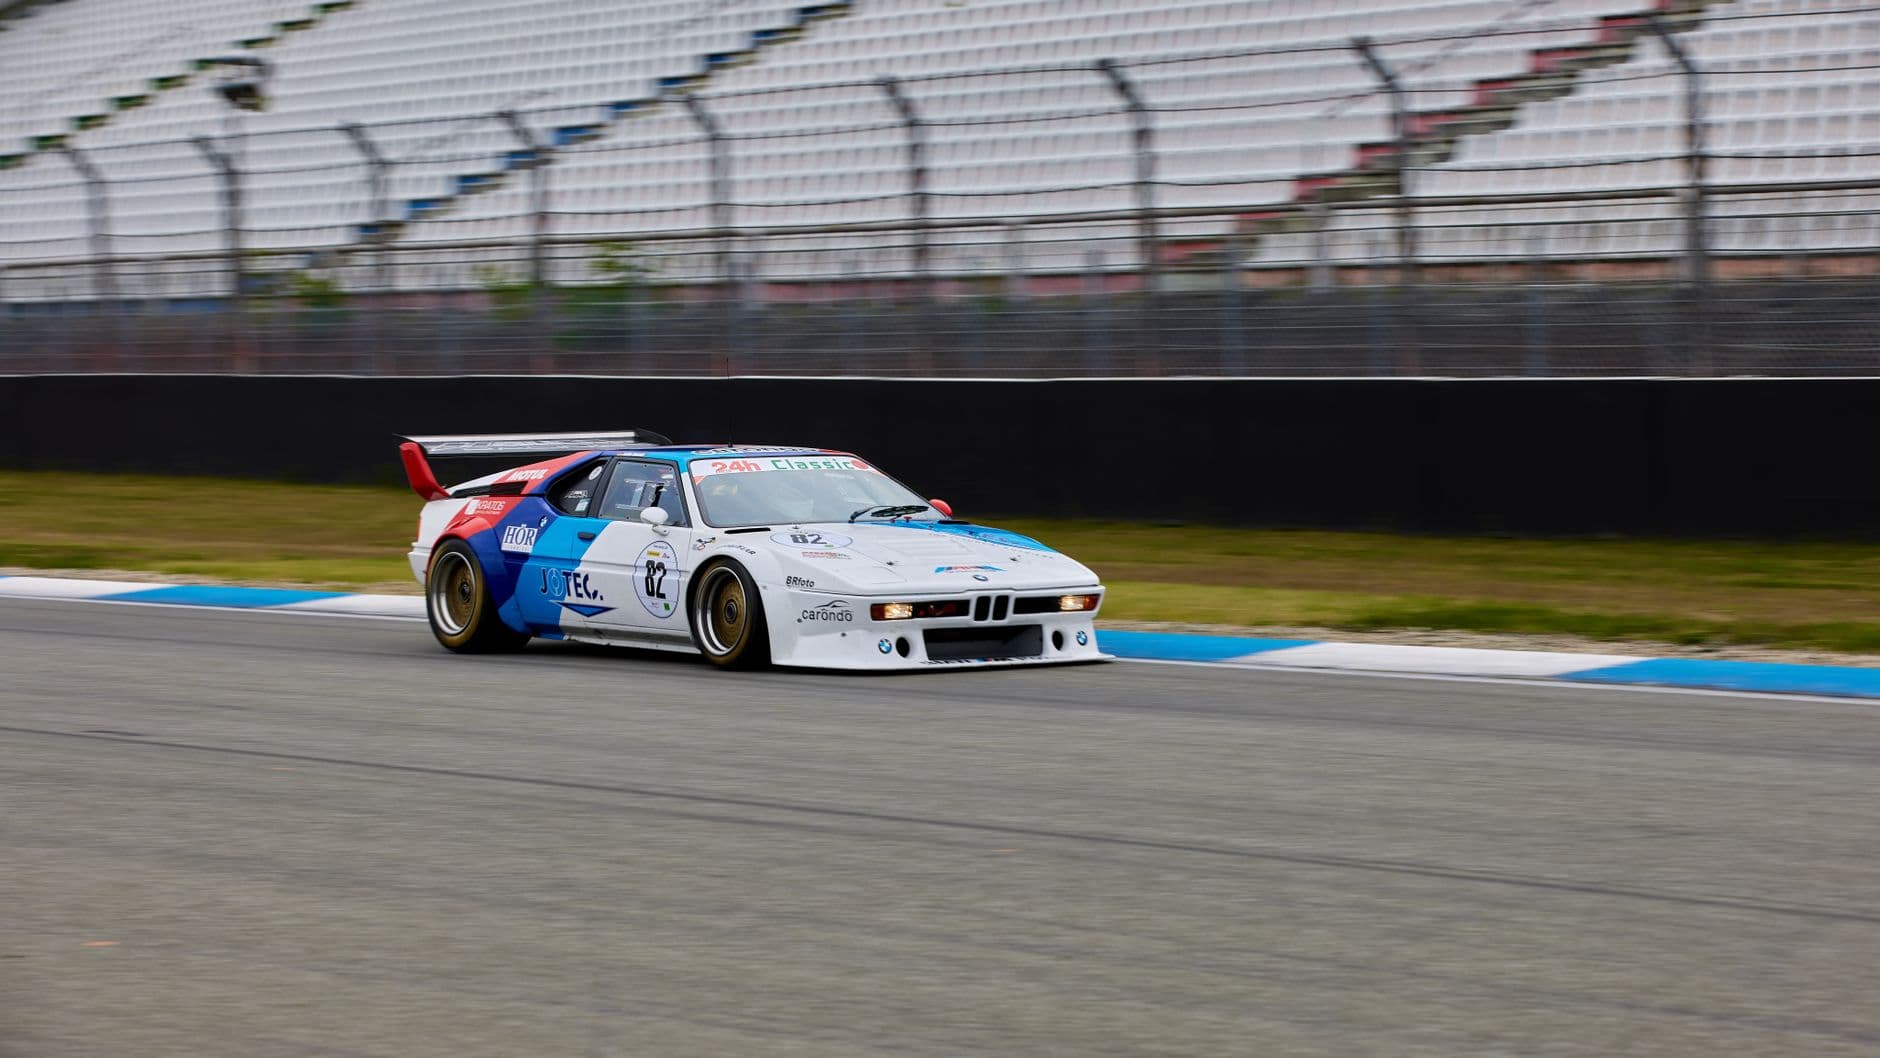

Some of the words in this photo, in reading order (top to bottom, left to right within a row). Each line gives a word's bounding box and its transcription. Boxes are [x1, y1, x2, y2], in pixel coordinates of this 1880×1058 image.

[711, 459, 762, 473] 24h
[771, 458, 852, 470] Classic
[507, 468, 549, 481] MOTUL
[504, 524, 536, 546] HÖR
[790, 533, 828, 545] 82
[645, 559, 667, 599] 82
[786, 575, 815, 588] BRfoto
